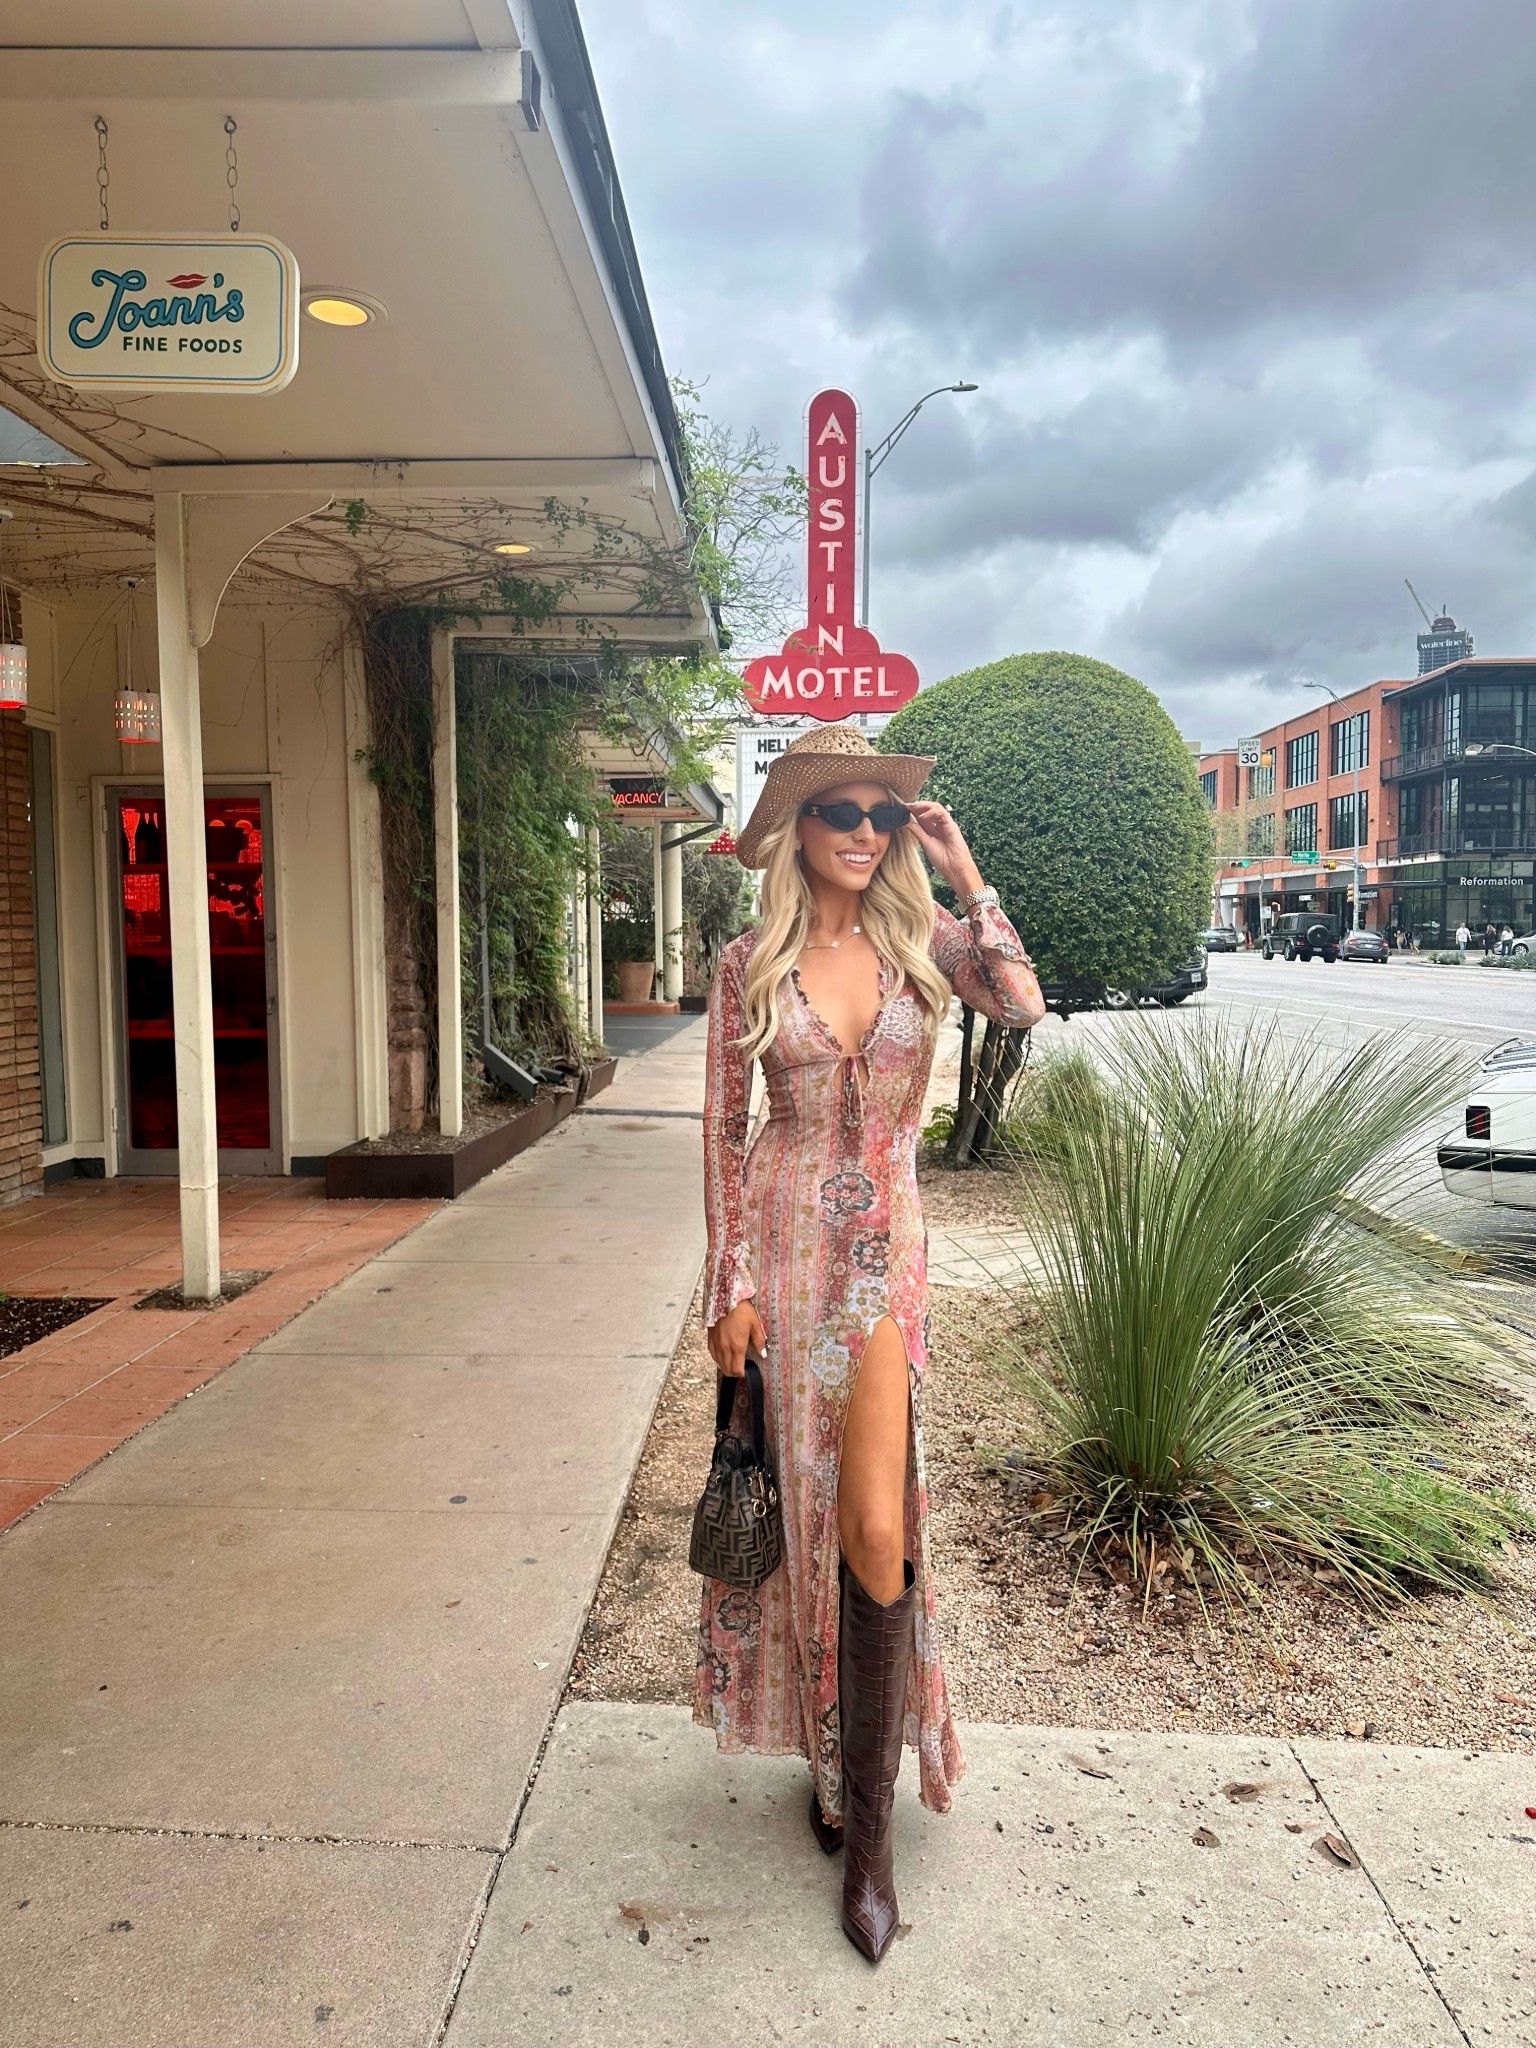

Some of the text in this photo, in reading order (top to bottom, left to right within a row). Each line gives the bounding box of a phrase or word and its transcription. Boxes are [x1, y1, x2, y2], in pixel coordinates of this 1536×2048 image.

[69, 269, 244, 349] Joann's
[123, 336, 243, 354] FINE FOODS
[816, 411, 848, 657] AUSTIN
[760, 665, 900, 700] MOTEL
[1241, 752, 1259, 764] 30
[611, 792, 664, 805] VACANCY
[1460, 876, 1524, 886] Reformation
